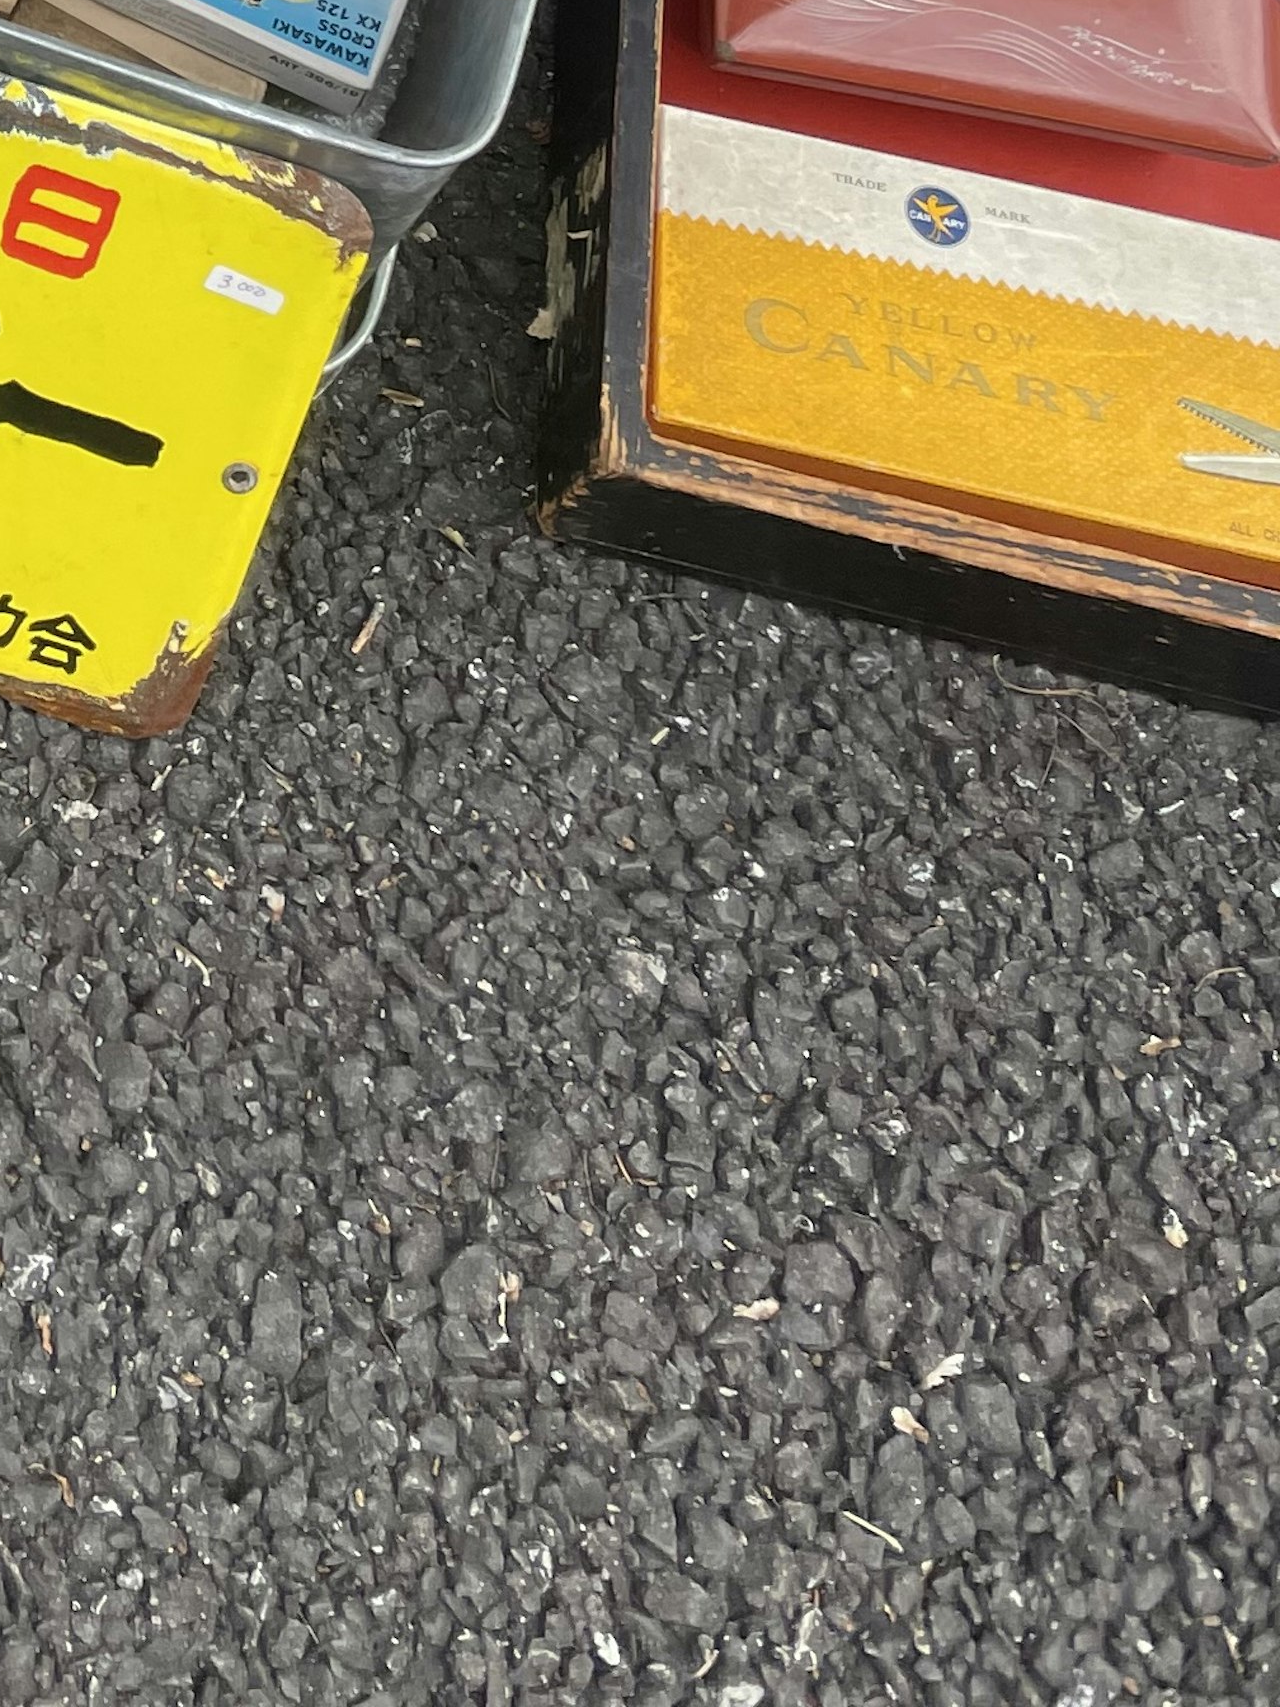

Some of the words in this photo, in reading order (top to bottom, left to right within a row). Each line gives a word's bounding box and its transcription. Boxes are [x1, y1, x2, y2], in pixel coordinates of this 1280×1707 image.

[271, 17, 370, 69] KAWASAKI
[319, 18, 376, 50] CROSS
[355, 13, 382, 32] KX
[832, 171, 888, 193] TRADE
[985, 205, 1031, 226] MARK
[838, 291, 1038, 352] YELLOW
[743, 296, 1119, 423] CANARY
